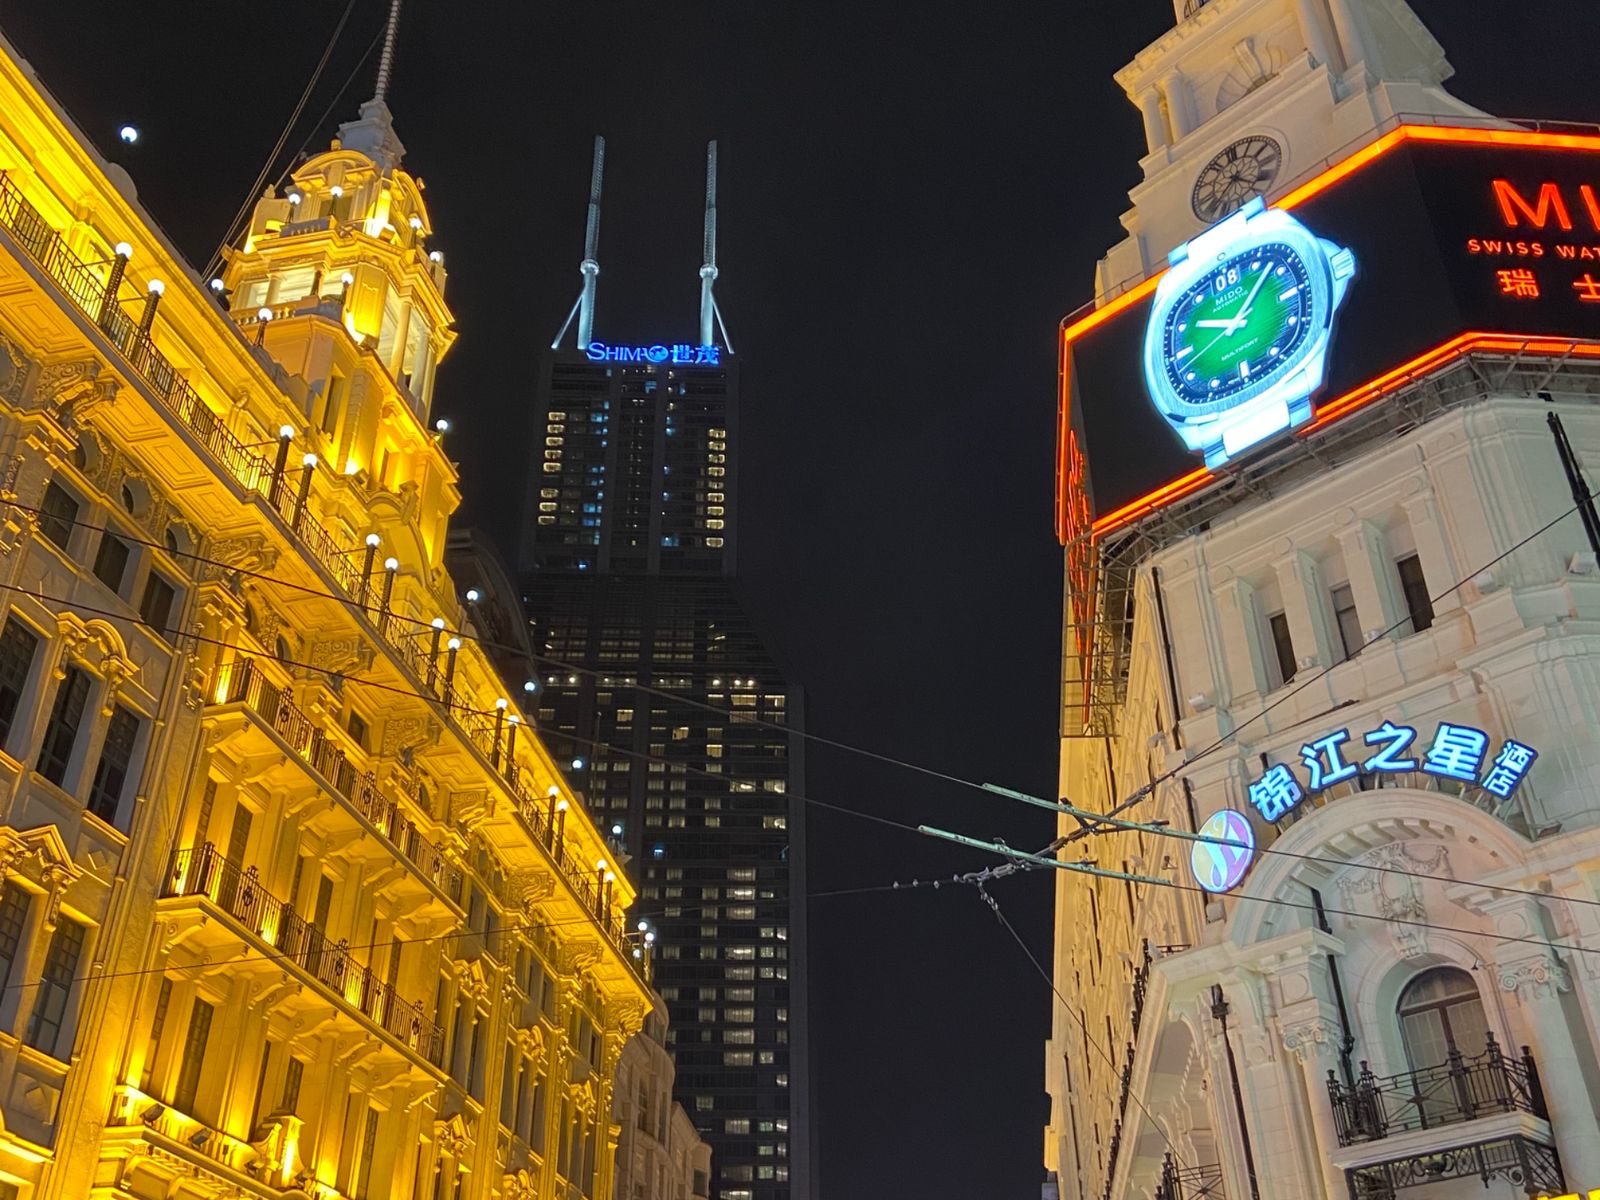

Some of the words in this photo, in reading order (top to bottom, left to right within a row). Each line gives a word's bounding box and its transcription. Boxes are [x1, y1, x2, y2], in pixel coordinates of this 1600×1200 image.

[1468, 239, 1543, 256] SWISS
[1215, 268, 1238, 291] 08
[1215, 286, 1243, 306] MIDO
[670, 344, 719, 364] 世茂
